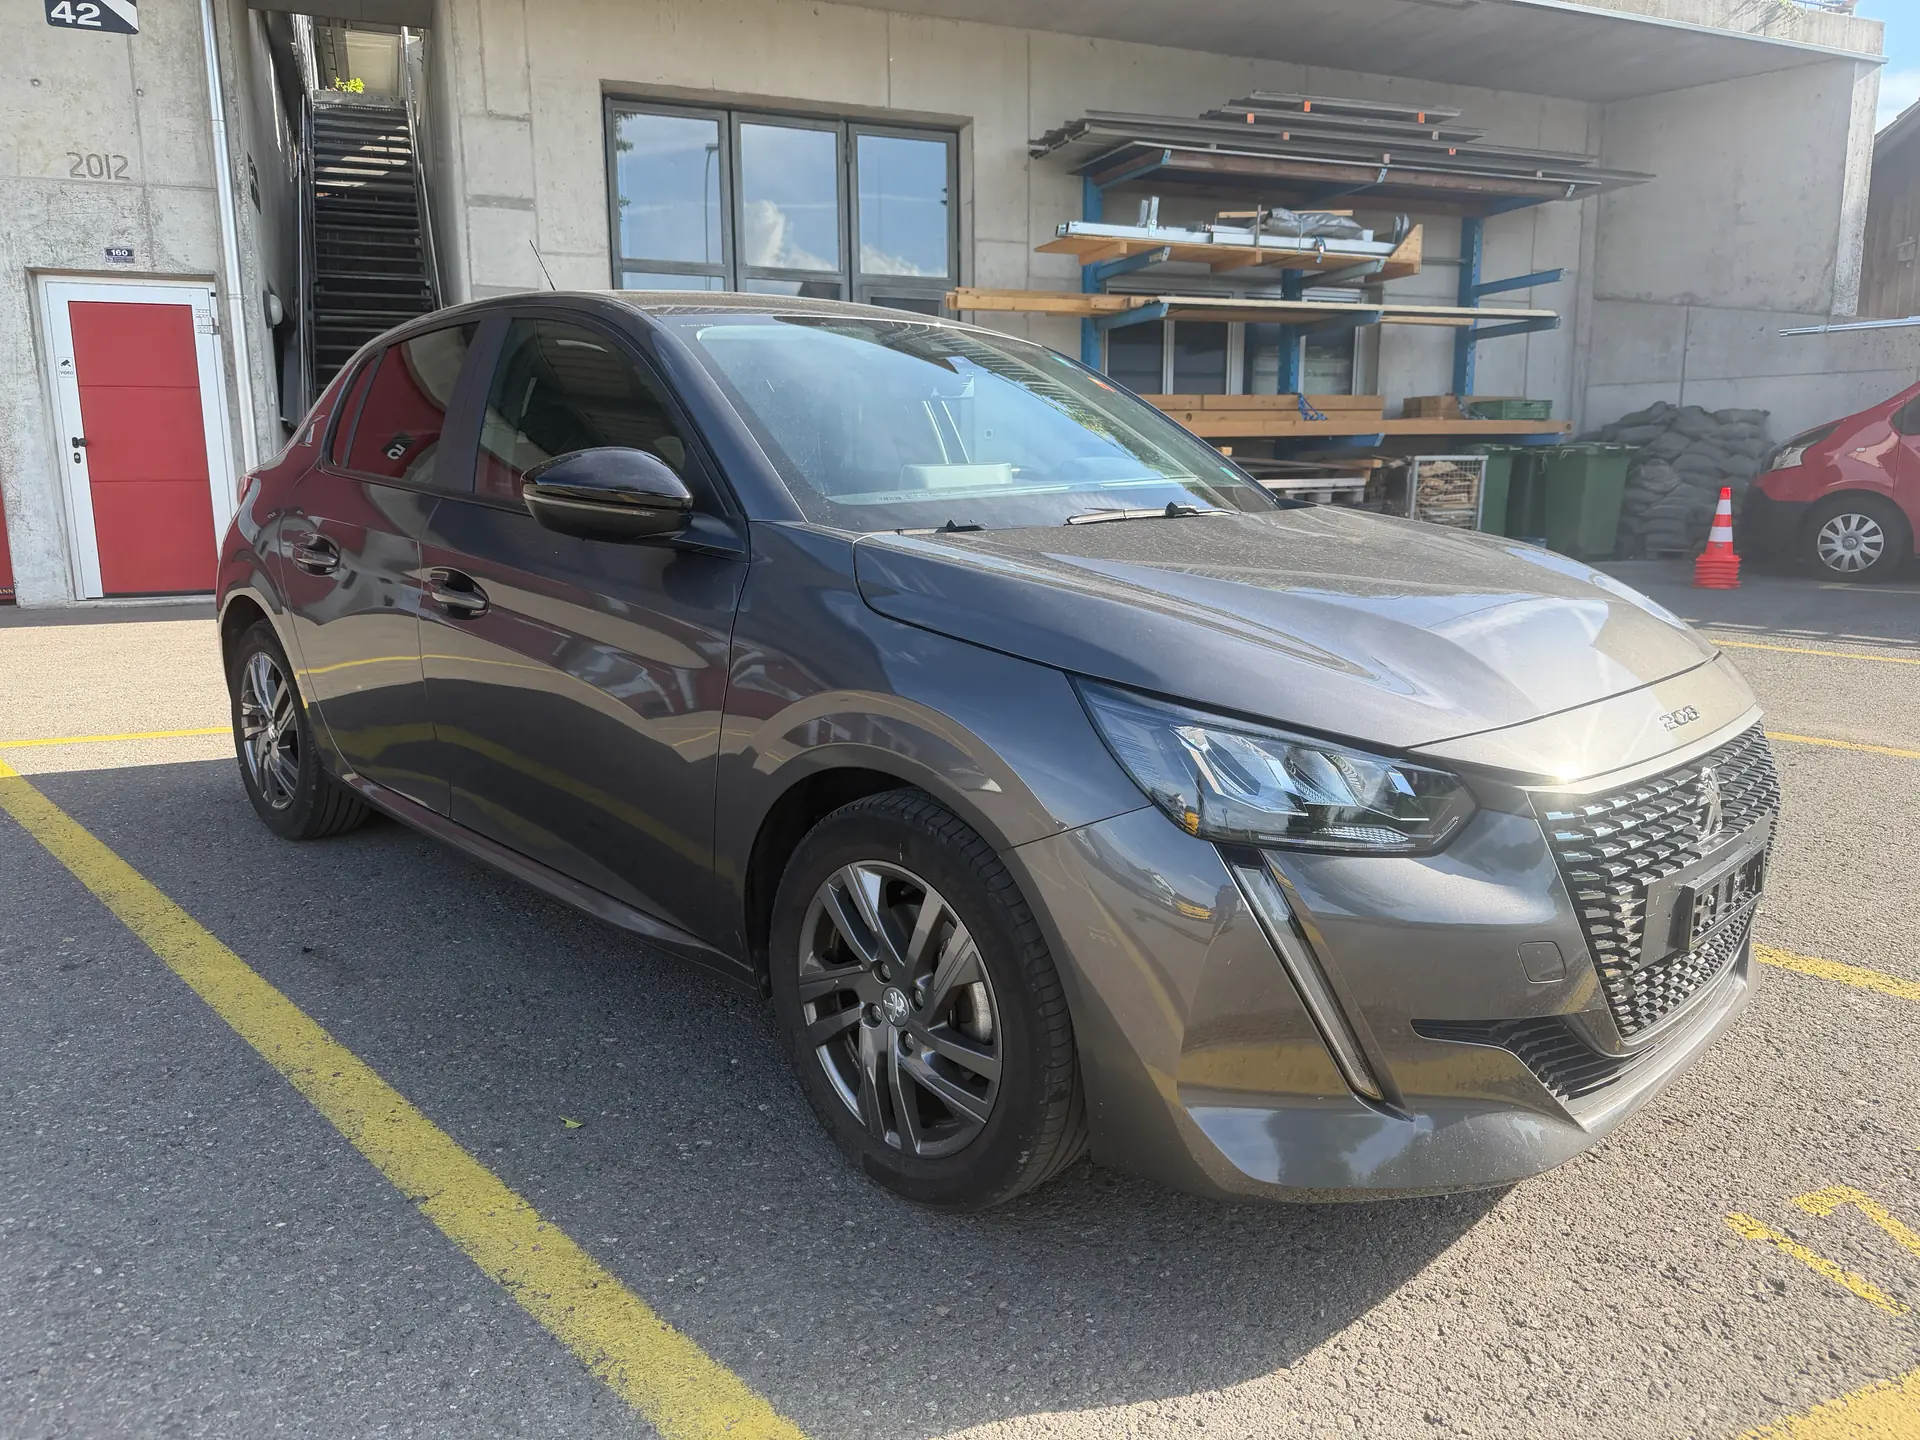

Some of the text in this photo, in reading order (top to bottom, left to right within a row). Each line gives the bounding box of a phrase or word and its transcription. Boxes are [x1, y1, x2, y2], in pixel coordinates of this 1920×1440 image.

[51, 1, 102, 27] 42
[66, 151, 131, 180] 2012
[1659, 704, 1700, 731] 208
